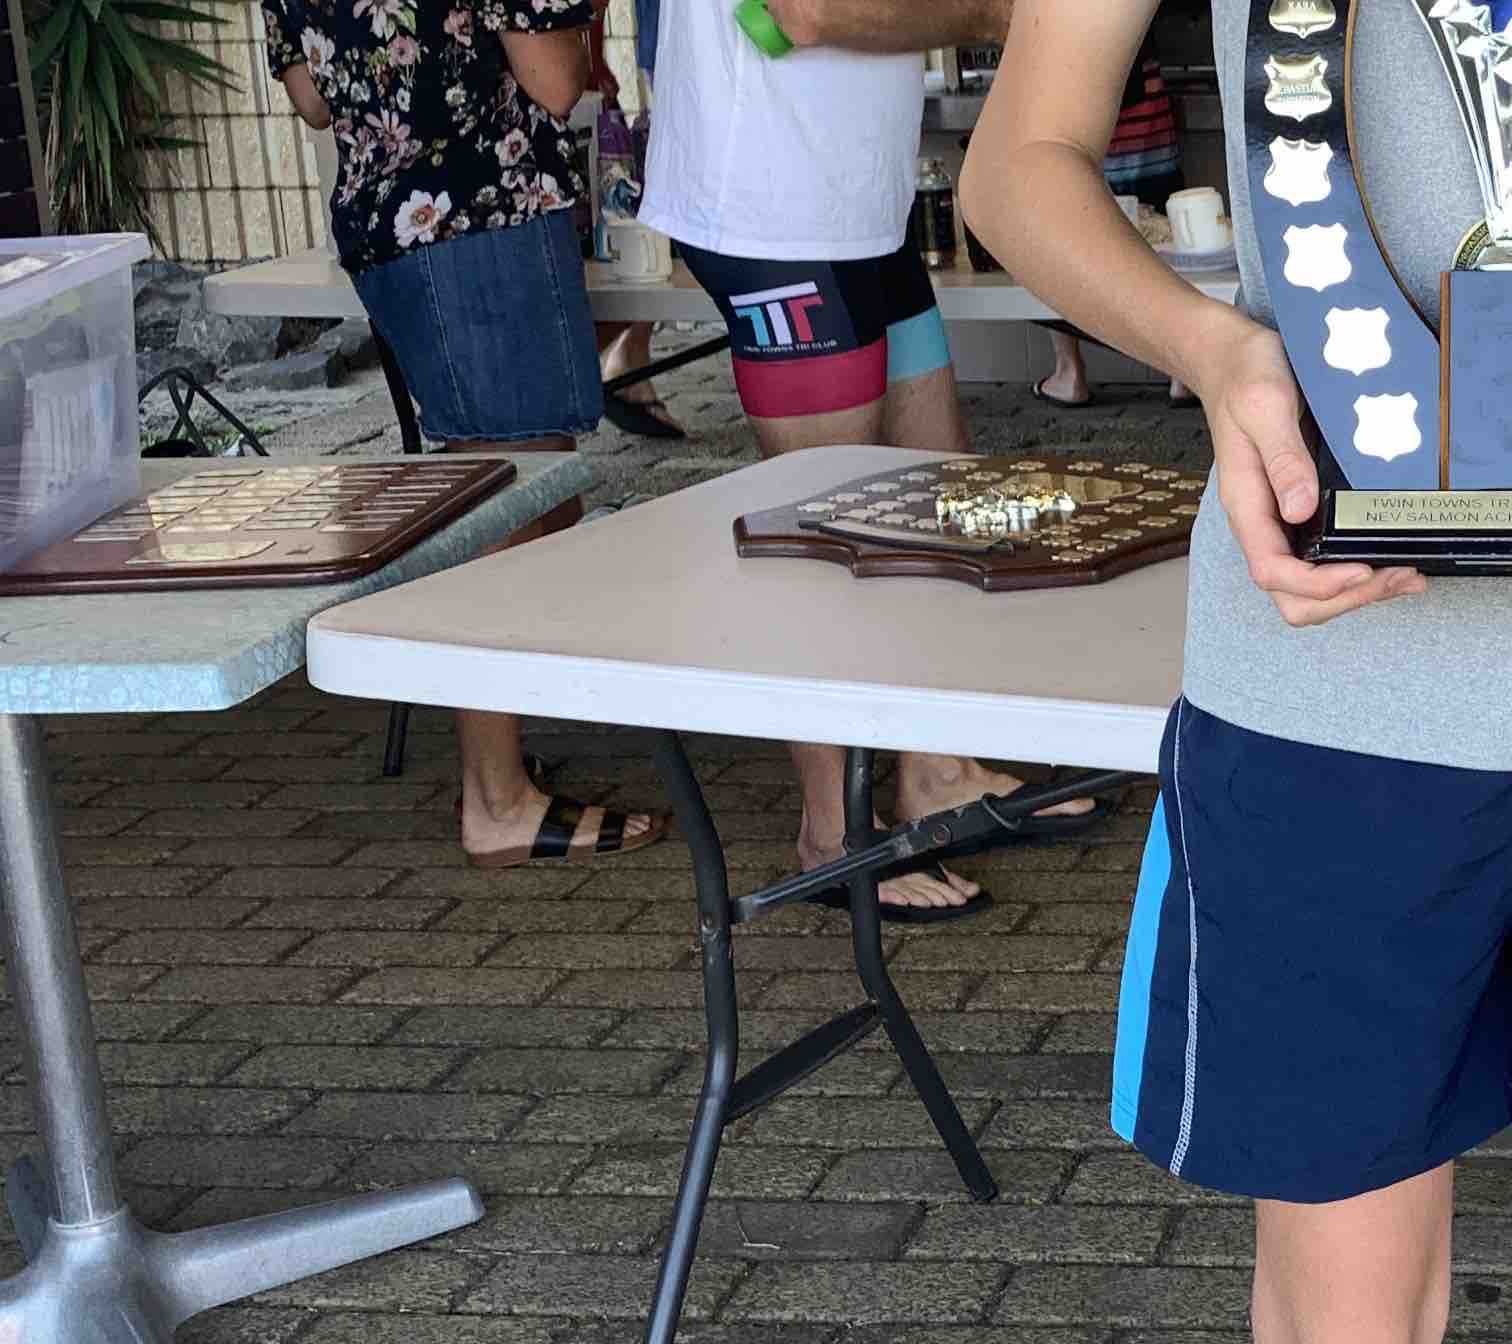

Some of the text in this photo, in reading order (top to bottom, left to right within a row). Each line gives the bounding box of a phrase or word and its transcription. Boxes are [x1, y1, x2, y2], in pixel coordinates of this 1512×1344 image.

[1373, 497, 1414, 509] TWIN
[1421, 497, 1482, 509] TOWNS
[1365, 511, 1401, 523] NEV
[1406, 511, 1479, 523] SALMON
